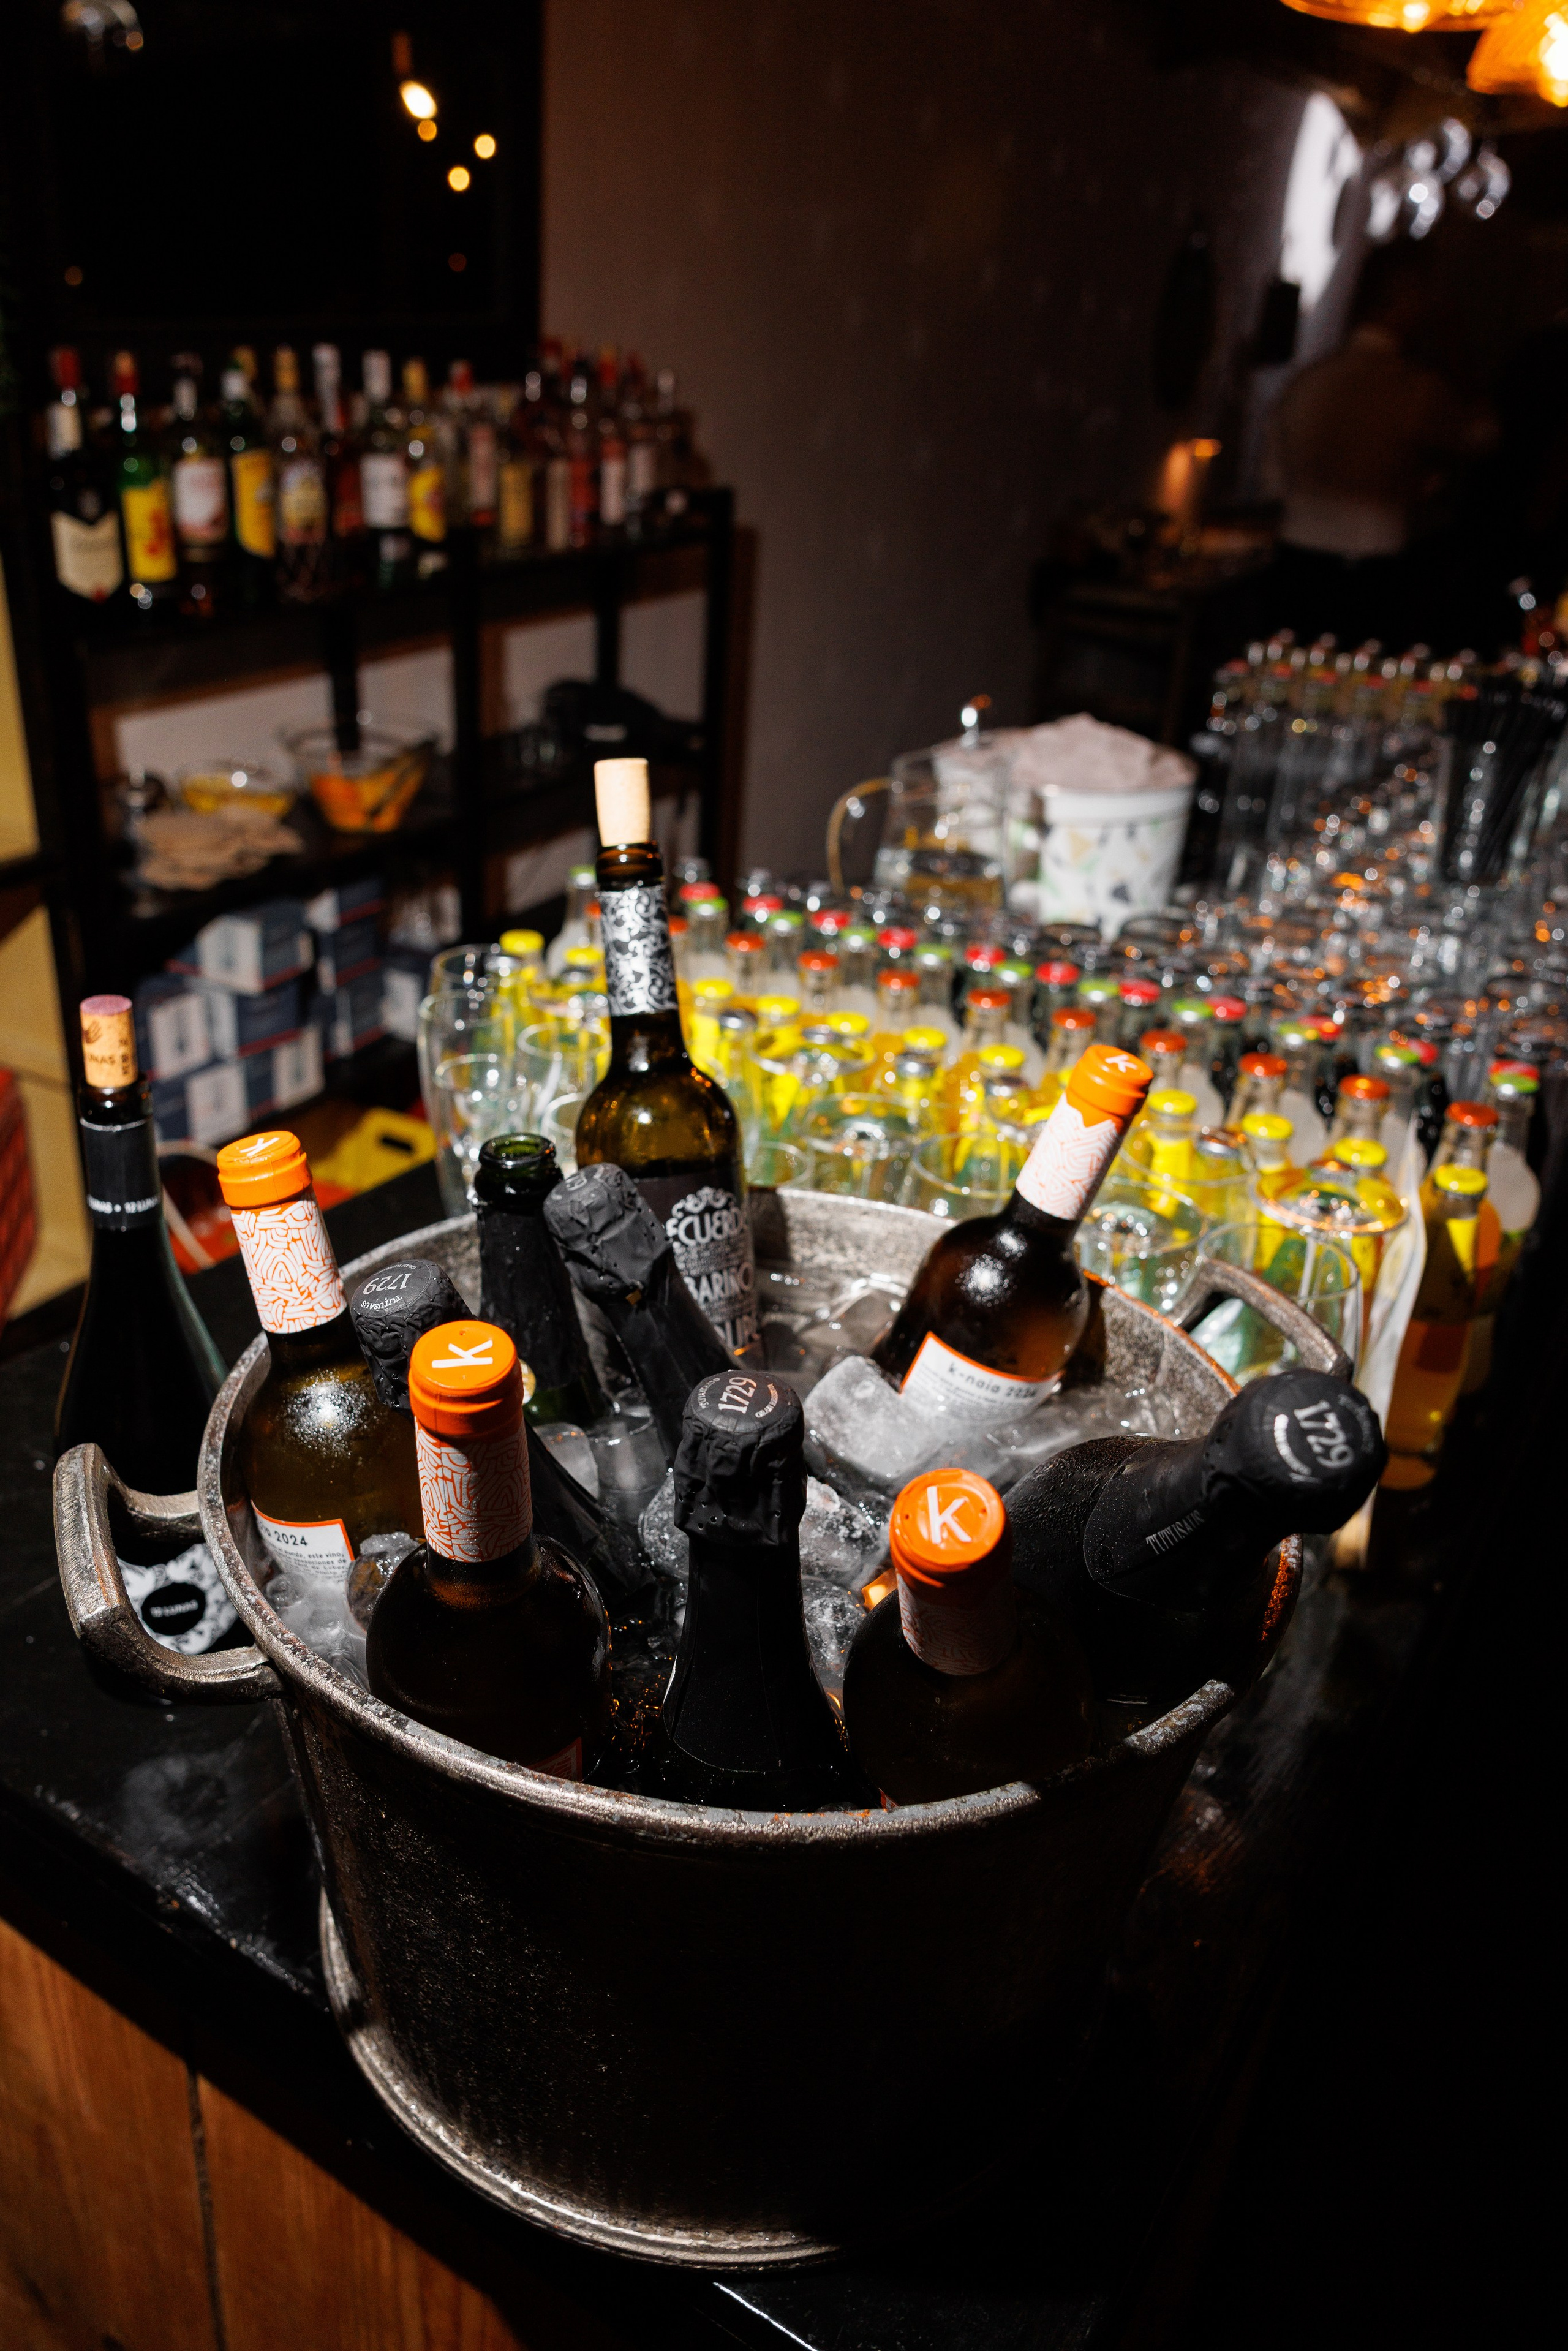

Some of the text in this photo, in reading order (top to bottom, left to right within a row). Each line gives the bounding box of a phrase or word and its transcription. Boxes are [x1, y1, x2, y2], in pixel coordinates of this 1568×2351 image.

[363, 1273, 412, 1296] 1729
[360, 1294, 403, 1311] TUTUSAUS
[718, 1376, 757, 1414] 1729
[1293, 1399, 1355, 1468] 1729
[274, 1530, 308, 1546] 2024
